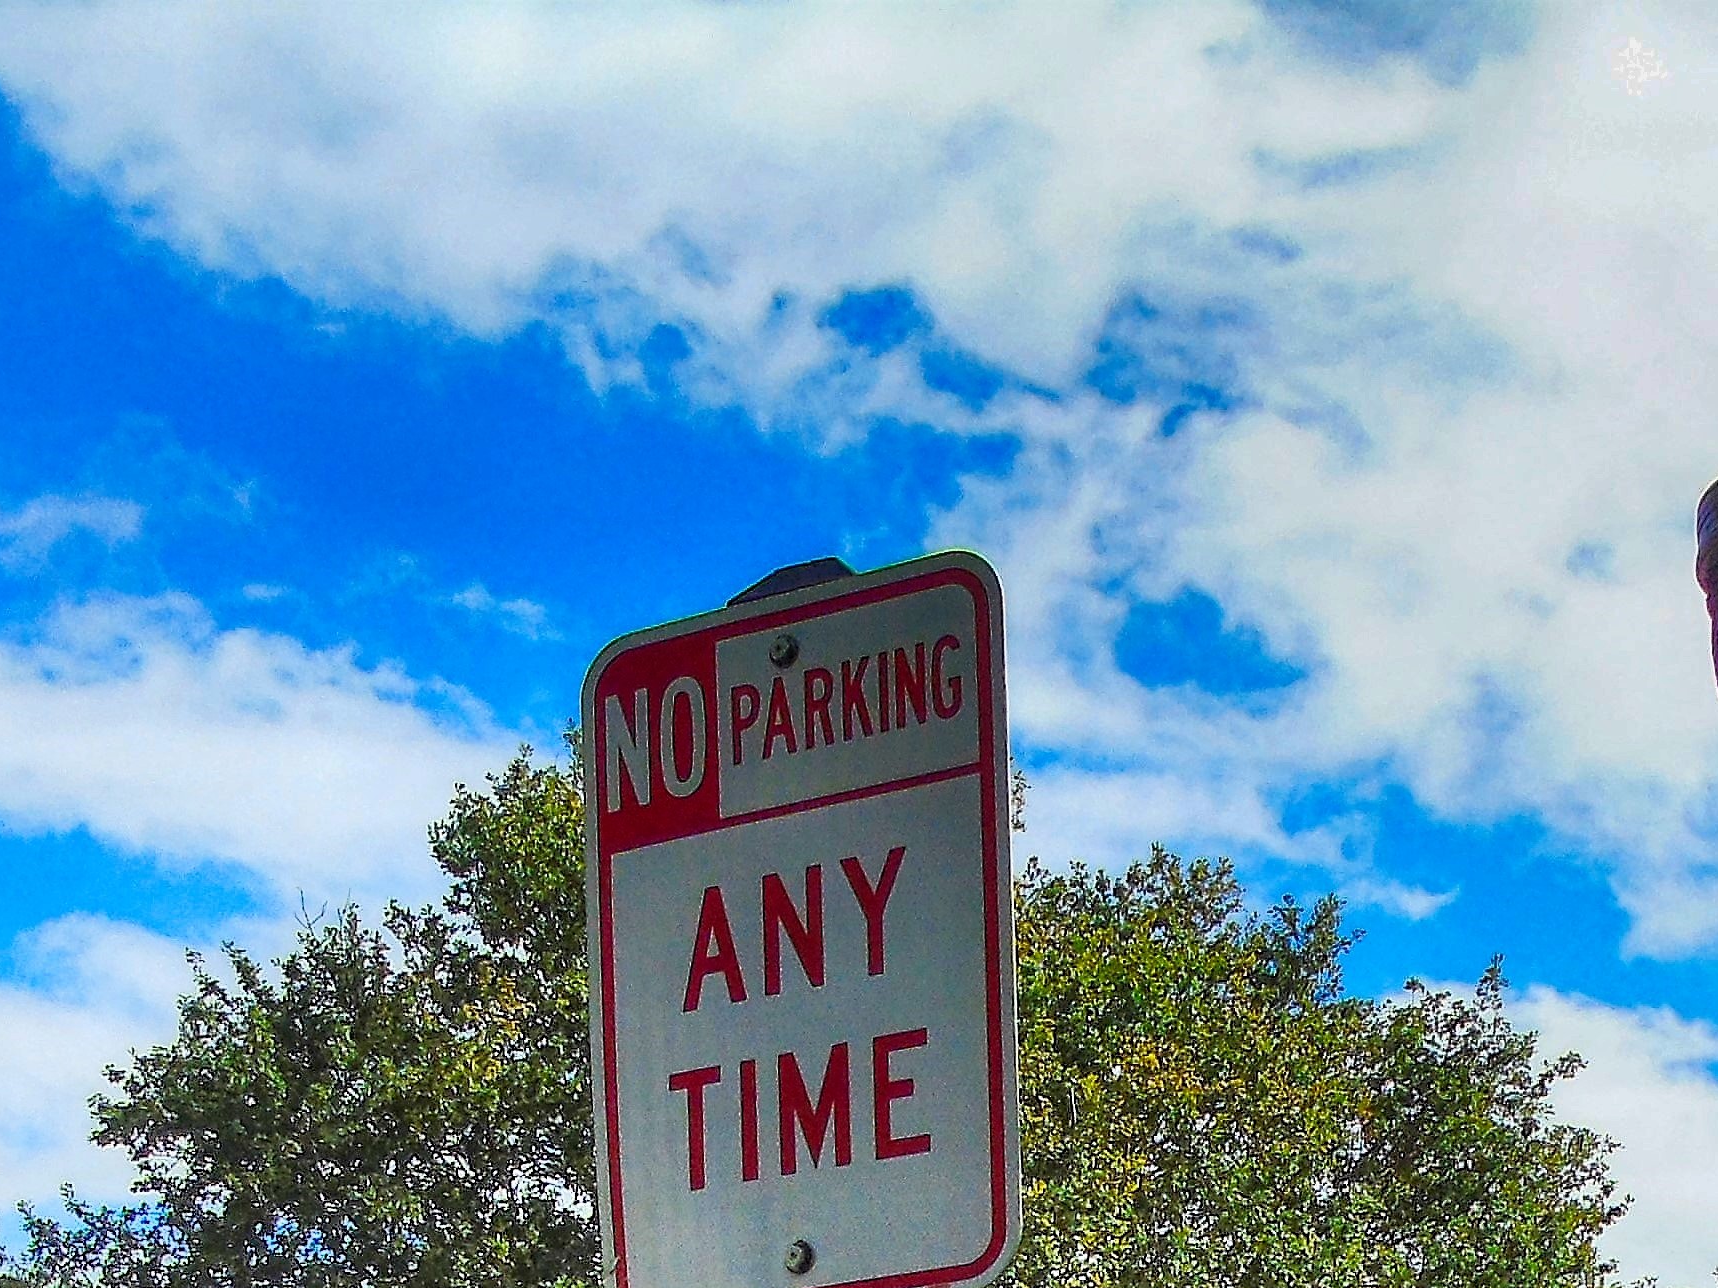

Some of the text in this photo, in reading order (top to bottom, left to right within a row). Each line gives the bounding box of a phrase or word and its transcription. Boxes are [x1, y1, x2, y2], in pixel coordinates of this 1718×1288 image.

[604, 633, 964, 814] NO PARKING
[682, 846, 907, 1012] ANY
[668, 1027, 932, 1191] TIME
